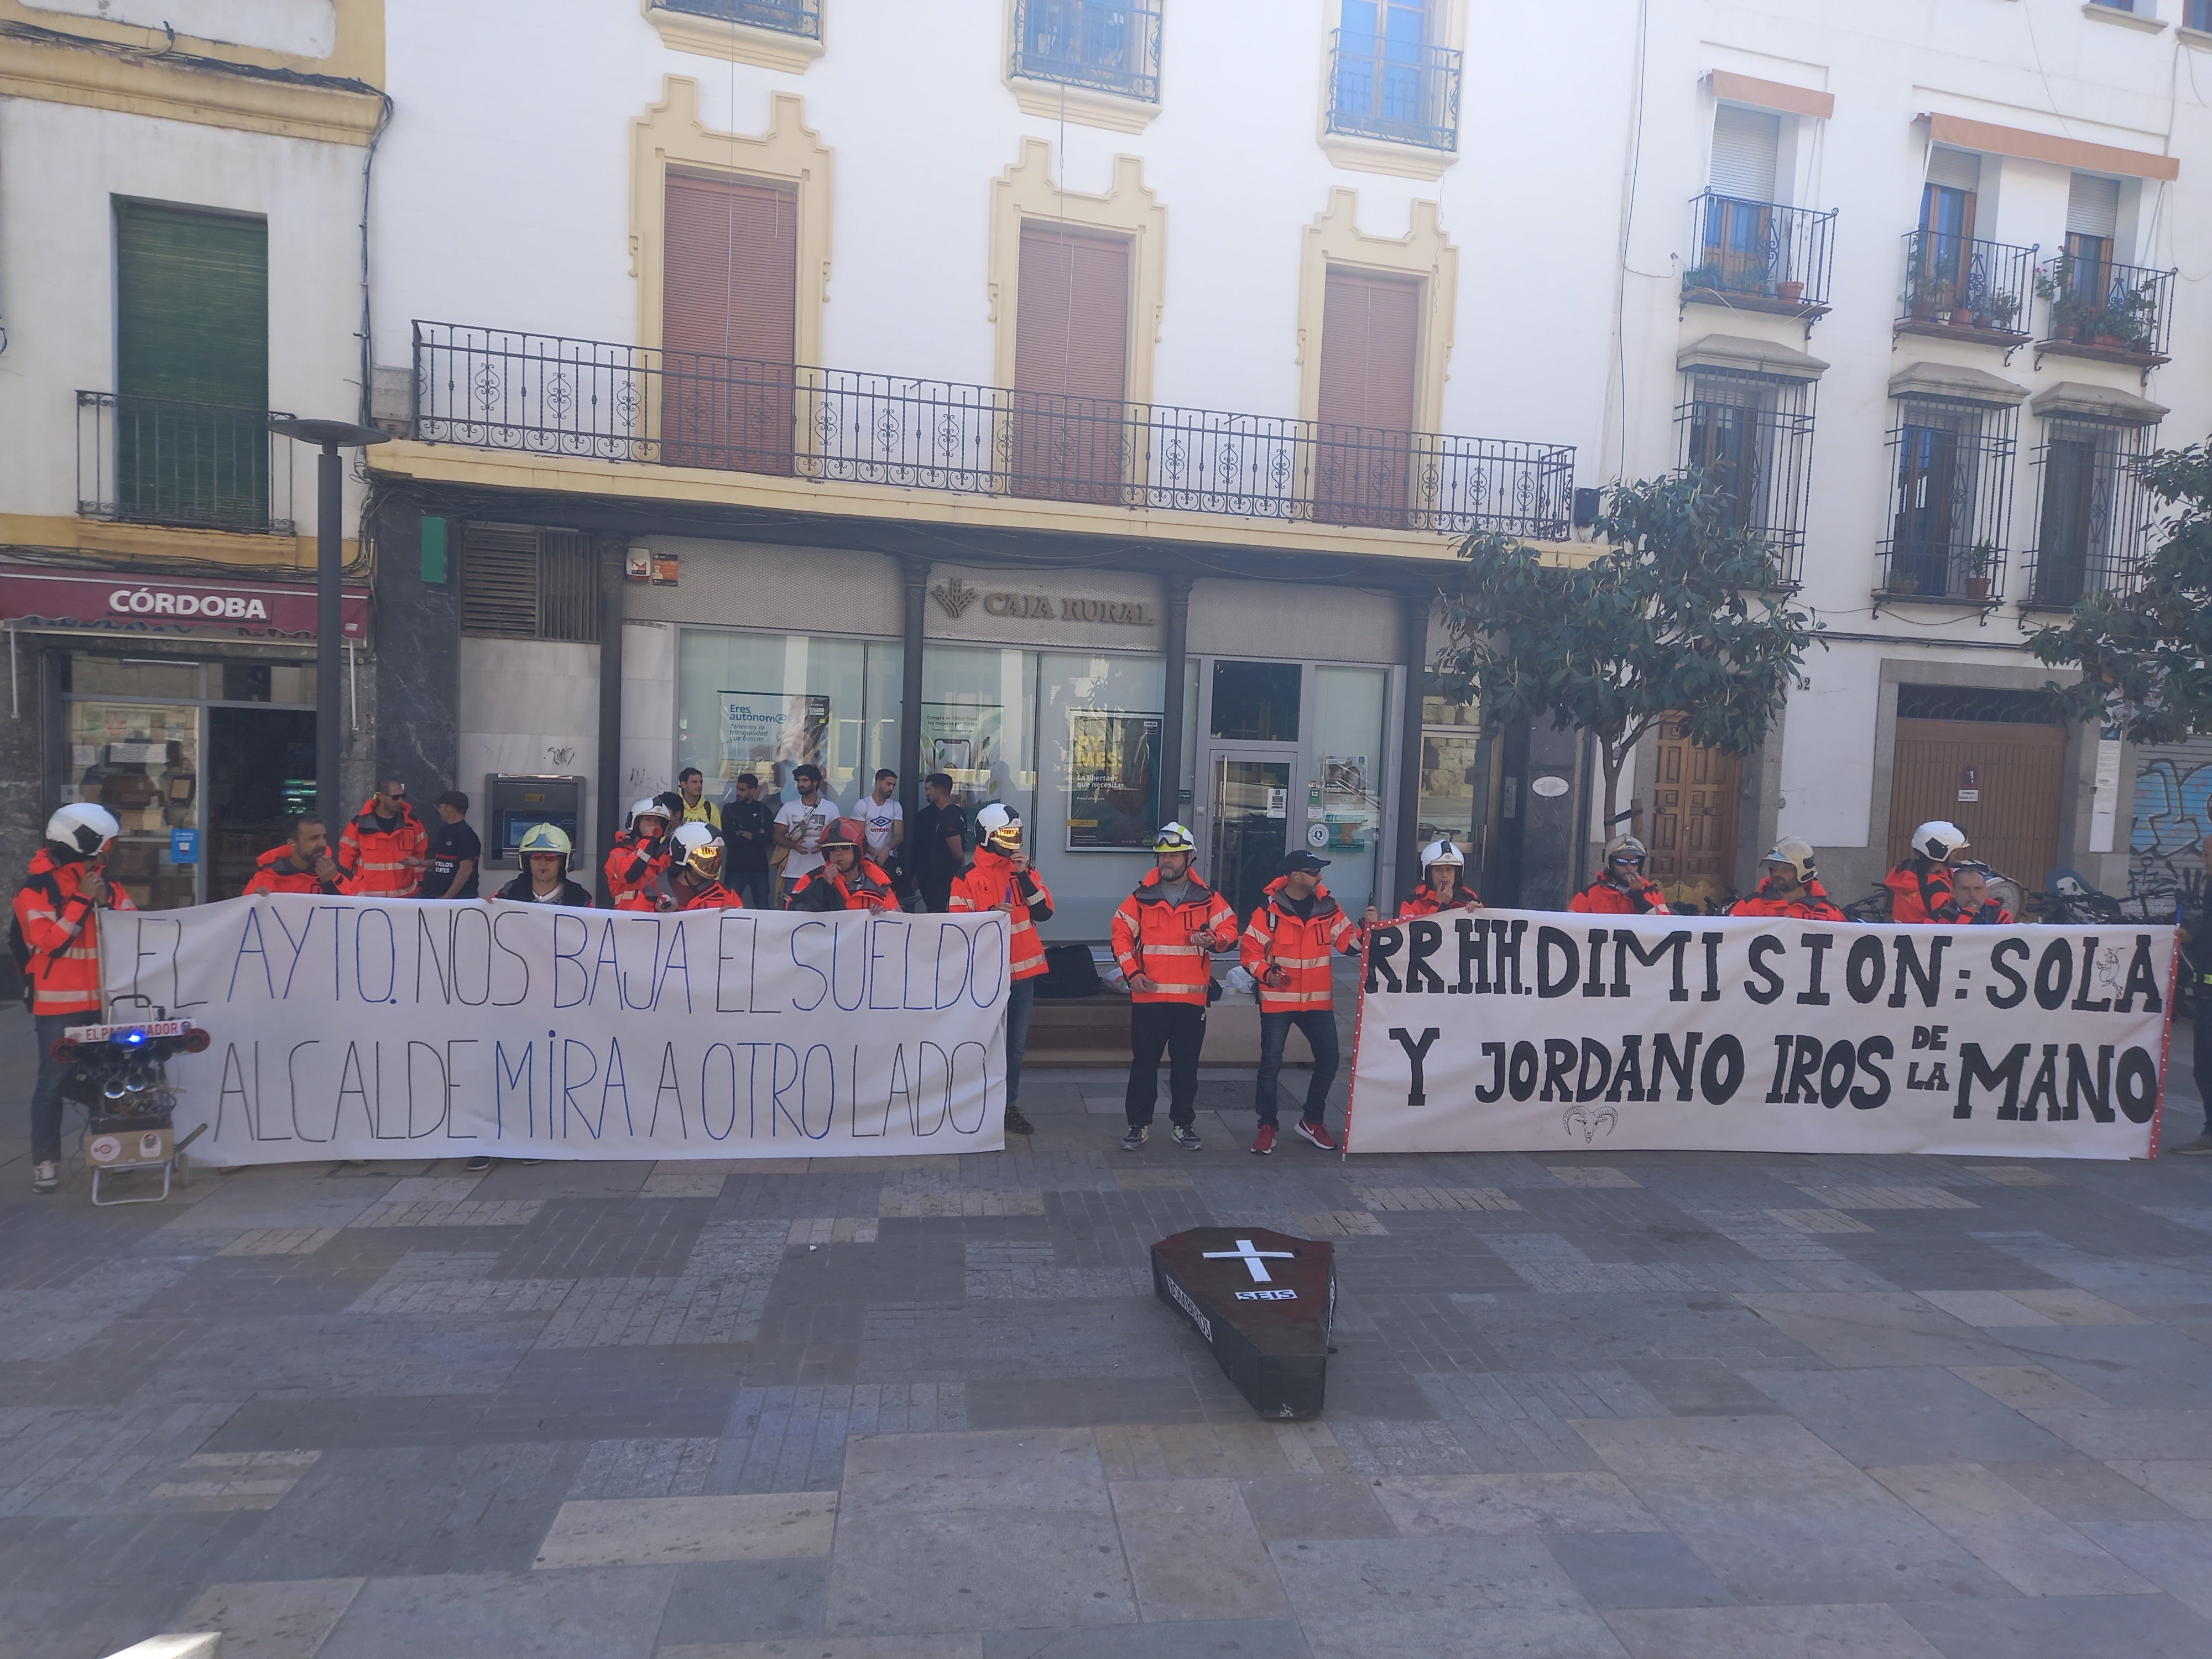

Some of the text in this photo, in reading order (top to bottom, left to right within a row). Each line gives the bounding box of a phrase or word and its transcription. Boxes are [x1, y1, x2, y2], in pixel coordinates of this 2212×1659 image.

[109, 588, 267, 619] CÓRDOBA
[984, 592, 1155, 625] CAJA RURAL
[729, 704, 751, 713] Eres
[729, 729, 769, 739] tranquilidad
[134, 906, 1004, 1014] EL AYTO. NOS BAJA EL SUELDO
[1985, 934, 2162, 1013] SOLA
[86, 1028, 100, 1041] EL
[213, 1039, 479, 1143] ALCALDE
[649, 1041, 687, 1140] A
[702, 1042, 834, 1140] OTRO
[852, 1040, 988, 1138] LADO
[1389, 1025, 2159, 1124] Y JORDANO IROS DE LA MANO
[1167, 1277, 1212, 1340] BOMBEROS
[1238, 1290, 1295, 1300] SEIS
